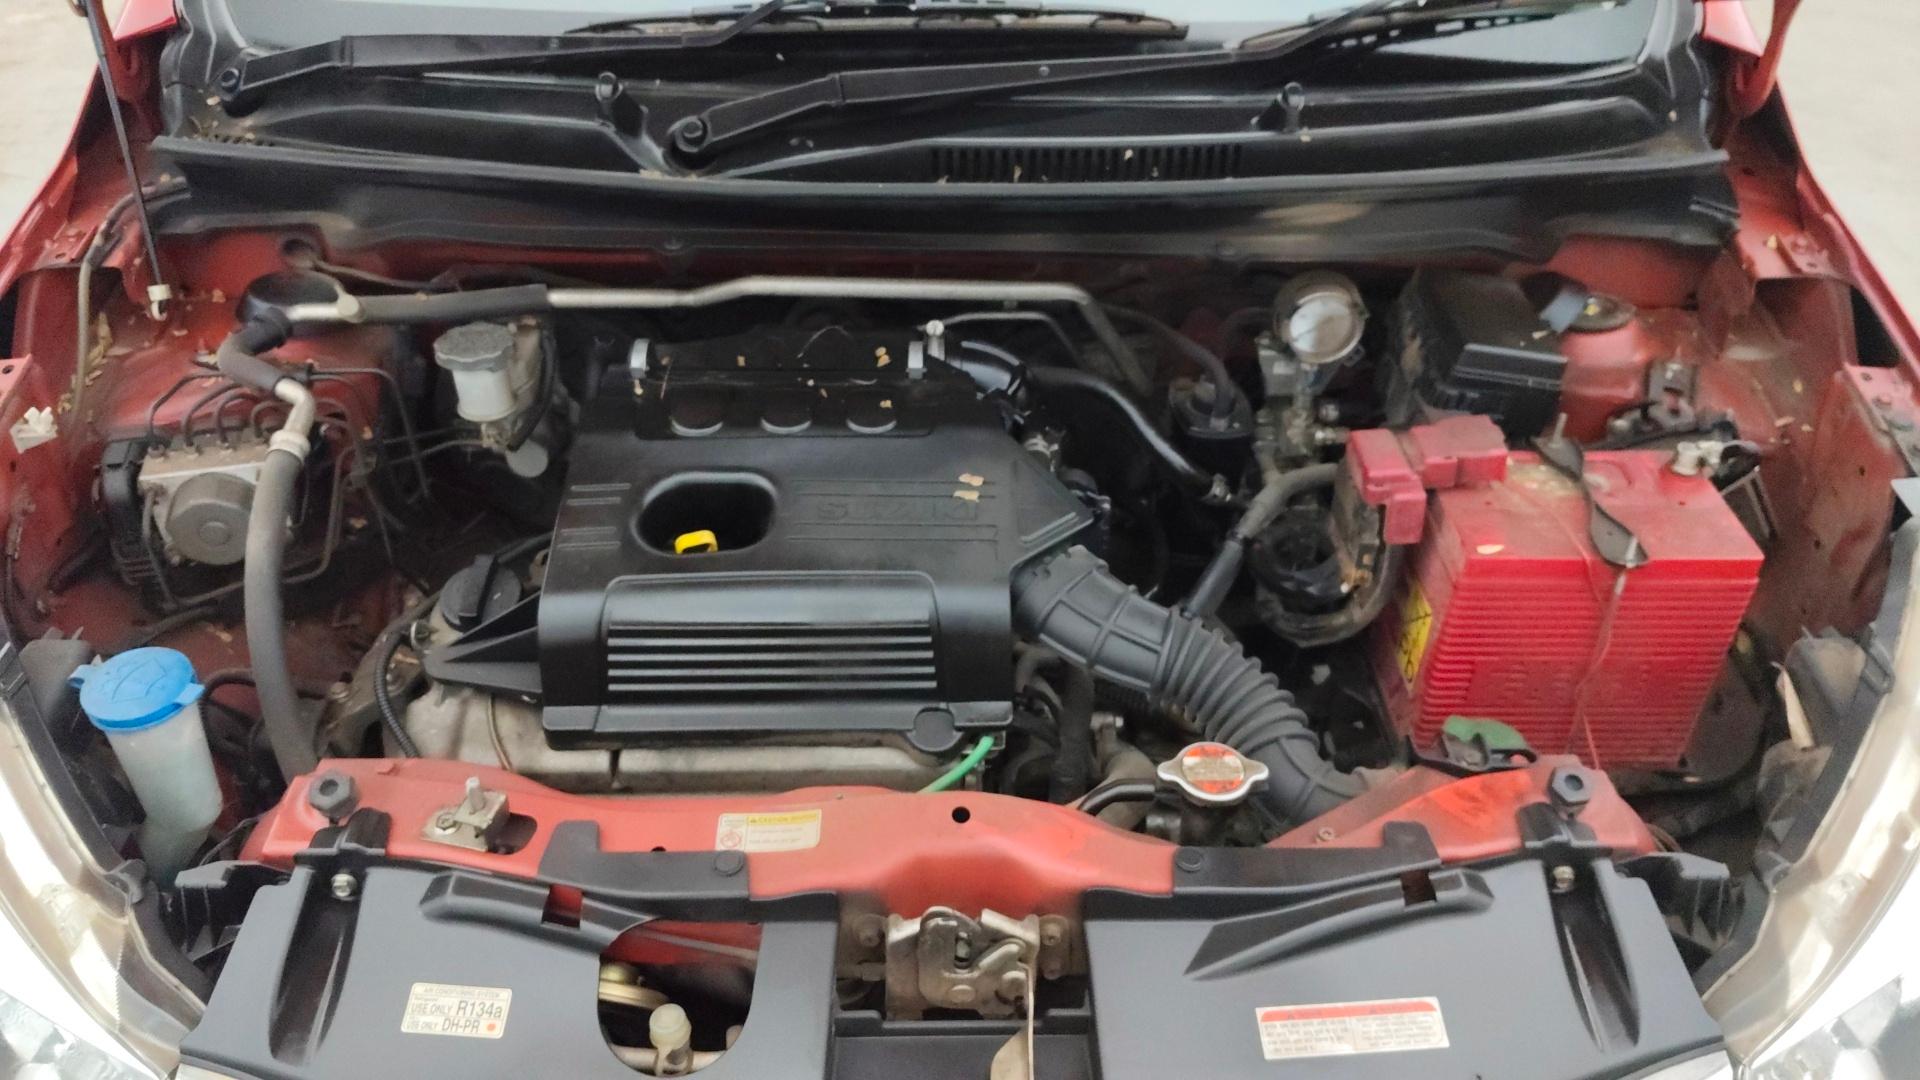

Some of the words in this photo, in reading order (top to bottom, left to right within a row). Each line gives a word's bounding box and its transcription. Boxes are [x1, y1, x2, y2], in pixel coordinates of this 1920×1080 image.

[411, 1003, 428, 1014] USE
[430, 1004, 454, 1015] ONLY
[456, 1000, 503, 1018] R134a
[441, 1017, 481, 1033] DH-PR
